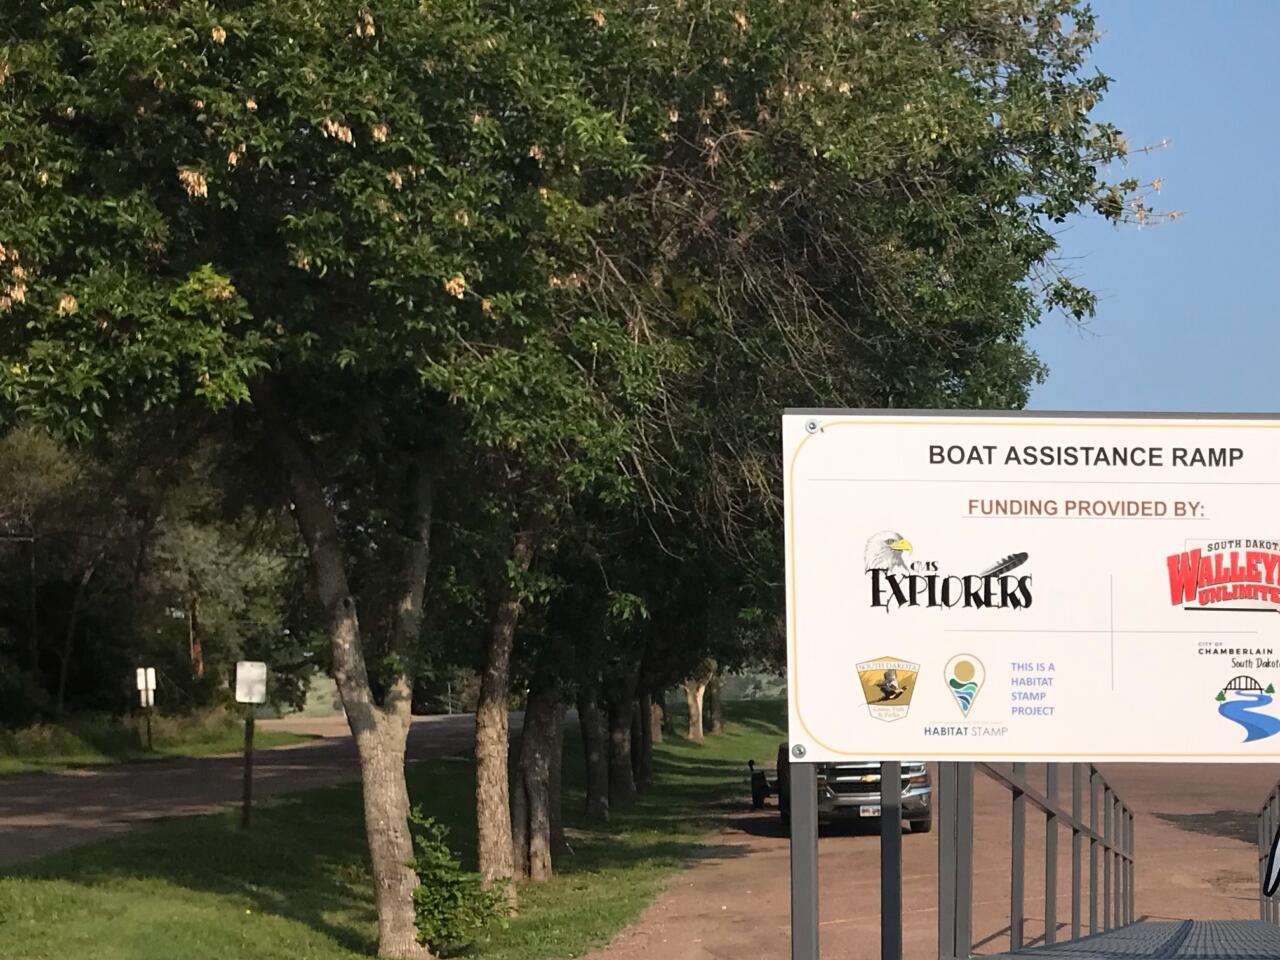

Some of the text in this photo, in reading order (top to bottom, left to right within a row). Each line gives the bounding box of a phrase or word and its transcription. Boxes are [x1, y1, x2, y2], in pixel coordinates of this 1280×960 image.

[929, 445, 1244, 467] BOAT ASSISTANCE RAMP
[968, 499, 1205, 517] FUNDING PROVIDED BY:
[1207, 540, 1241, 552] SOUTH
[865, 569, 1032, 613] EXPLORERS
[1011, 662, 1055, 672] THIS IS A
[1231, 657, 1254, 669] South
[1011, 677, 1053, 687] HABITAT
[1011, 692, 1046, 701] STAMP
[1011, 706, 1055, 716] PROJECT
[924, 726, 1009, 737] HABITAT STAMP
